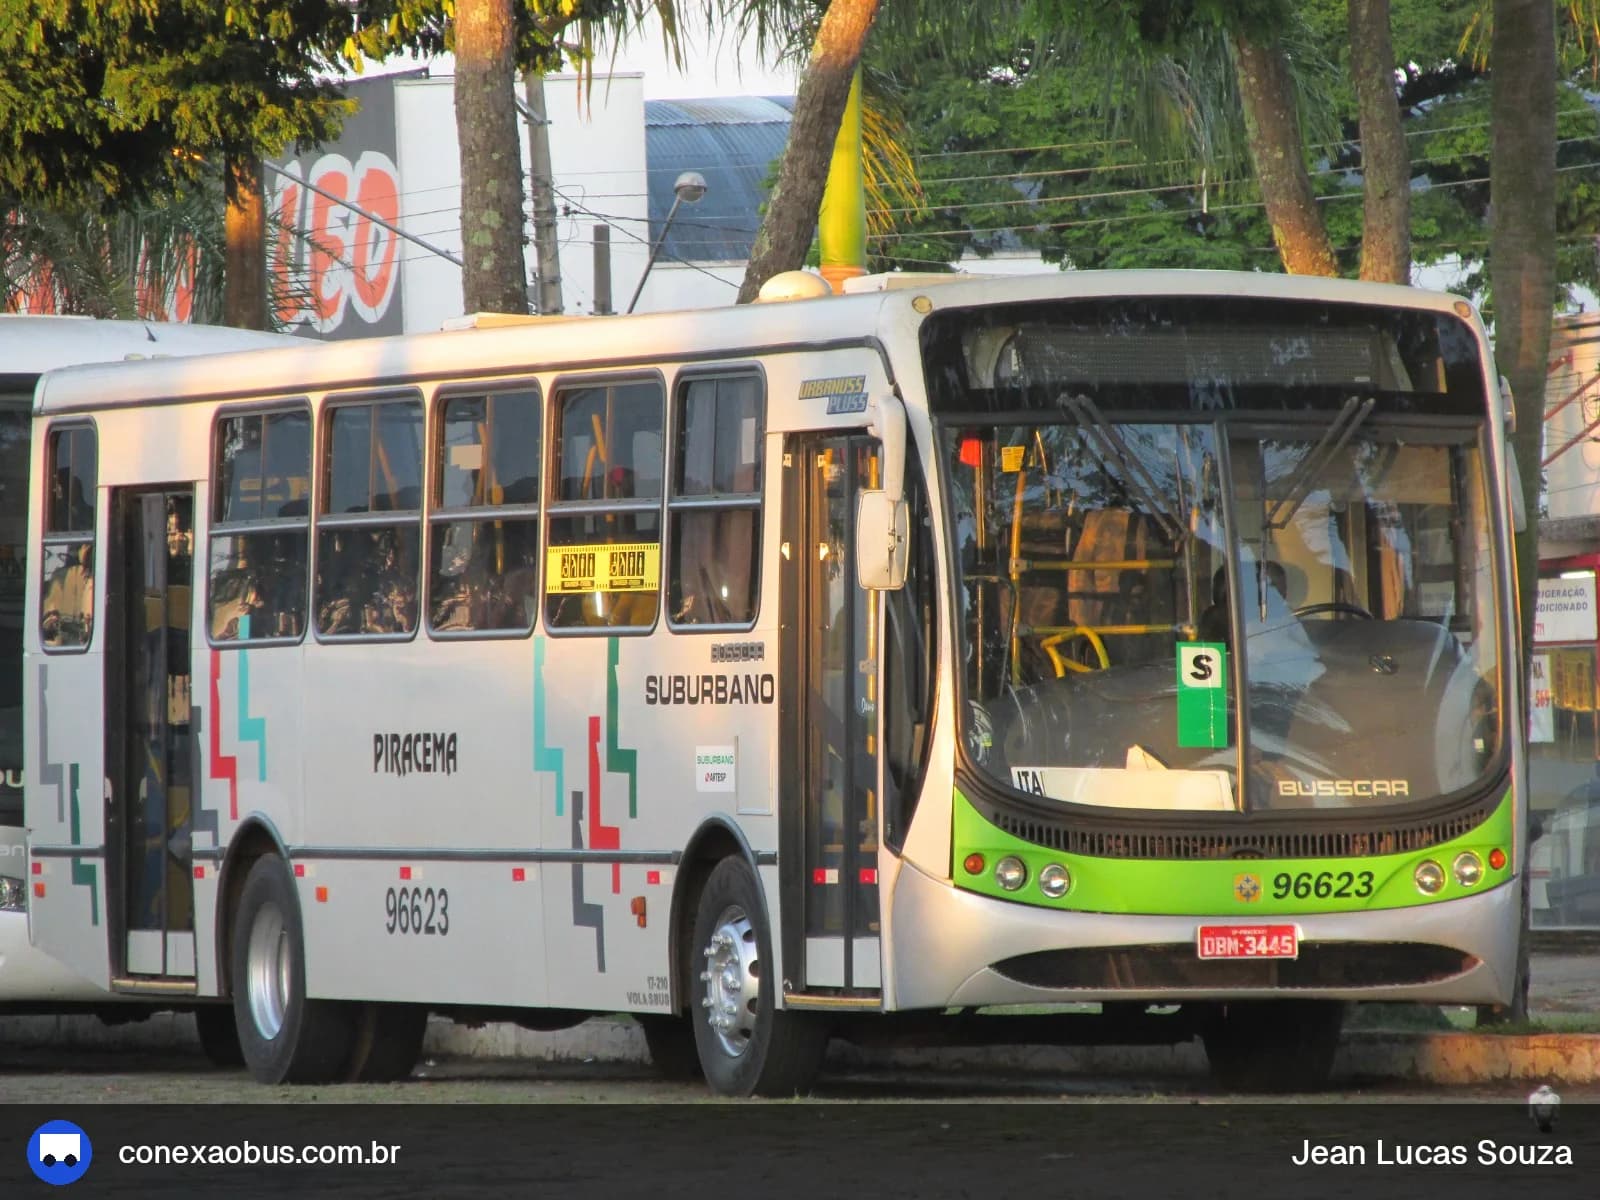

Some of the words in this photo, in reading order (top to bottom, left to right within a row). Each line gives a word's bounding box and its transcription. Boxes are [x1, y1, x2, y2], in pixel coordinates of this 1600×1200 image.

[1190, 654, 1213, 681] S
[645, 674, 775, 705] SUBURBANO
[373, 732, 457, 776] PIRACEMA
[696, 755, 734, 765] SUBURBANO
[1278, 780, 1409, 797] BUSSCAR
[1273, 871, 1375, 900] 96623
[385, 887, 449, 936] 96623
